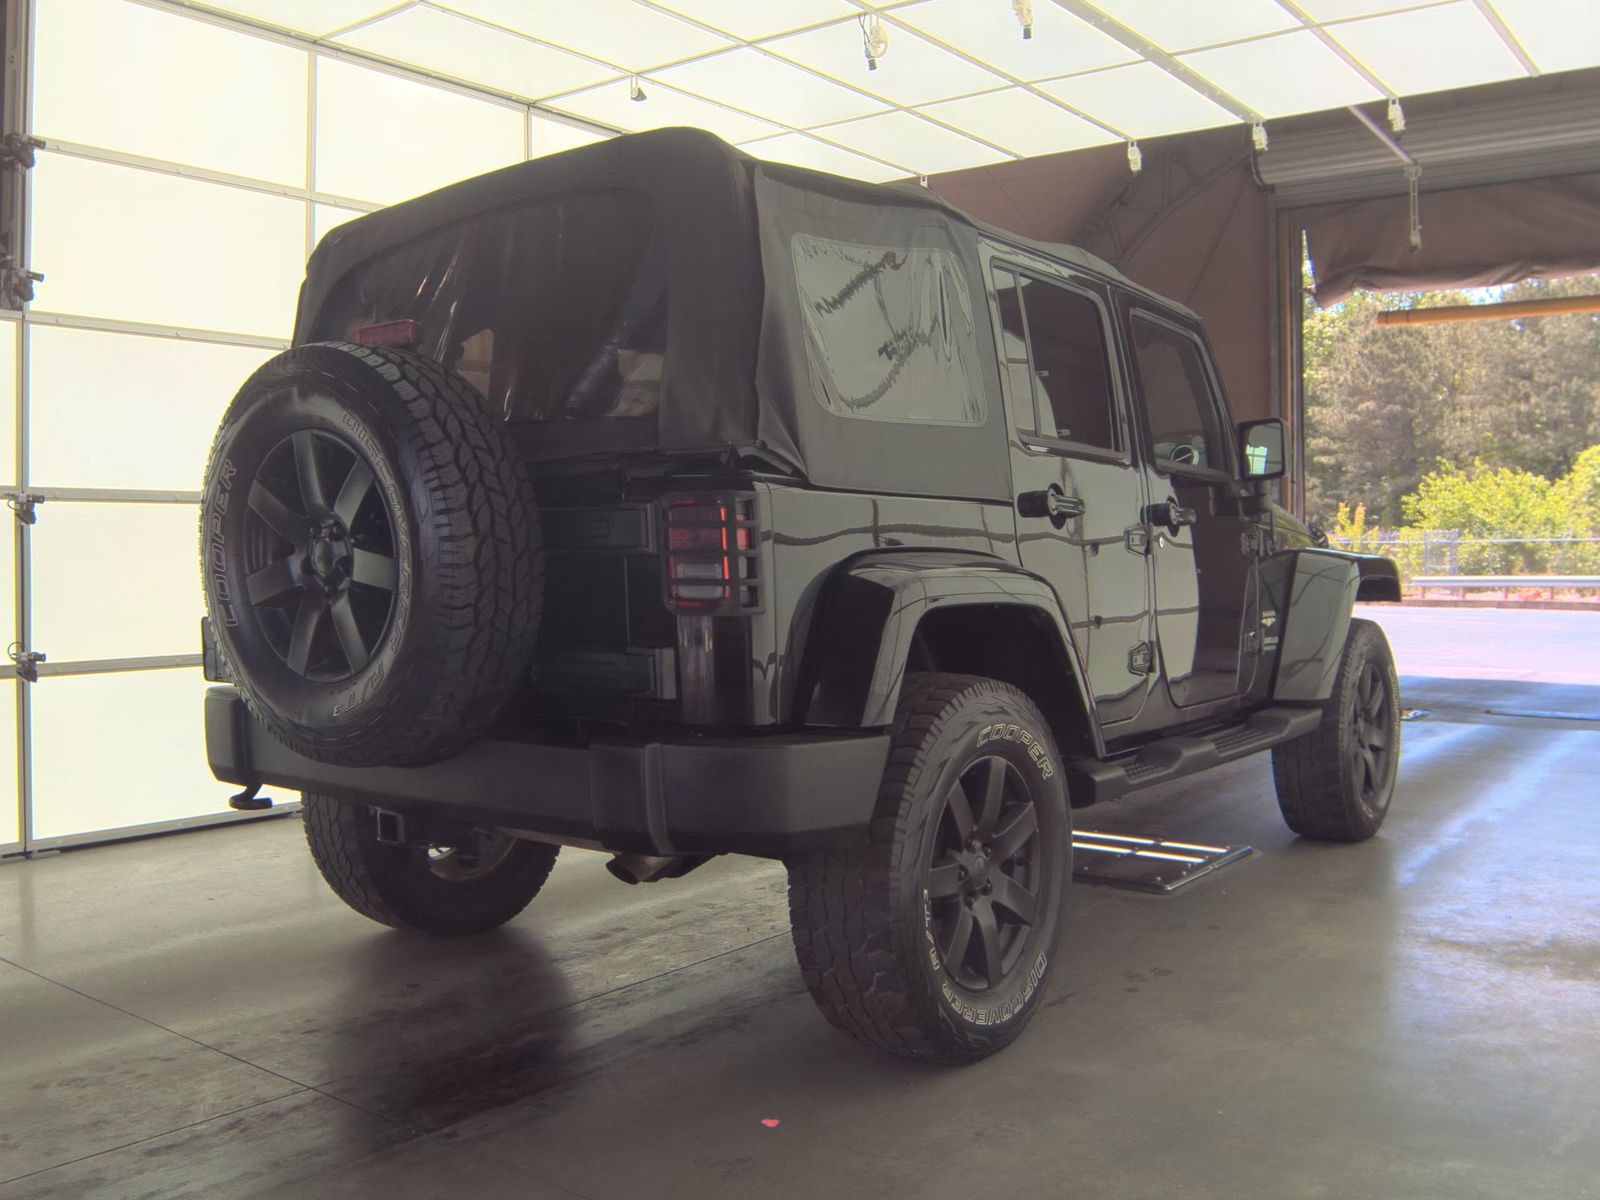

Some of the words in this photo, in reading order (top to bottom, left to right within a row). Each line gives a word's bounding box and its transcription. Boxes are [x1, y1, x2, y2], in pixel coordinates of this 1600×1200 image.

[211, 459, 238, 627] COOPER
[977, 724, 1053, 780] COOPER
[941, 951, 1047, 1025] DISCOVERER
